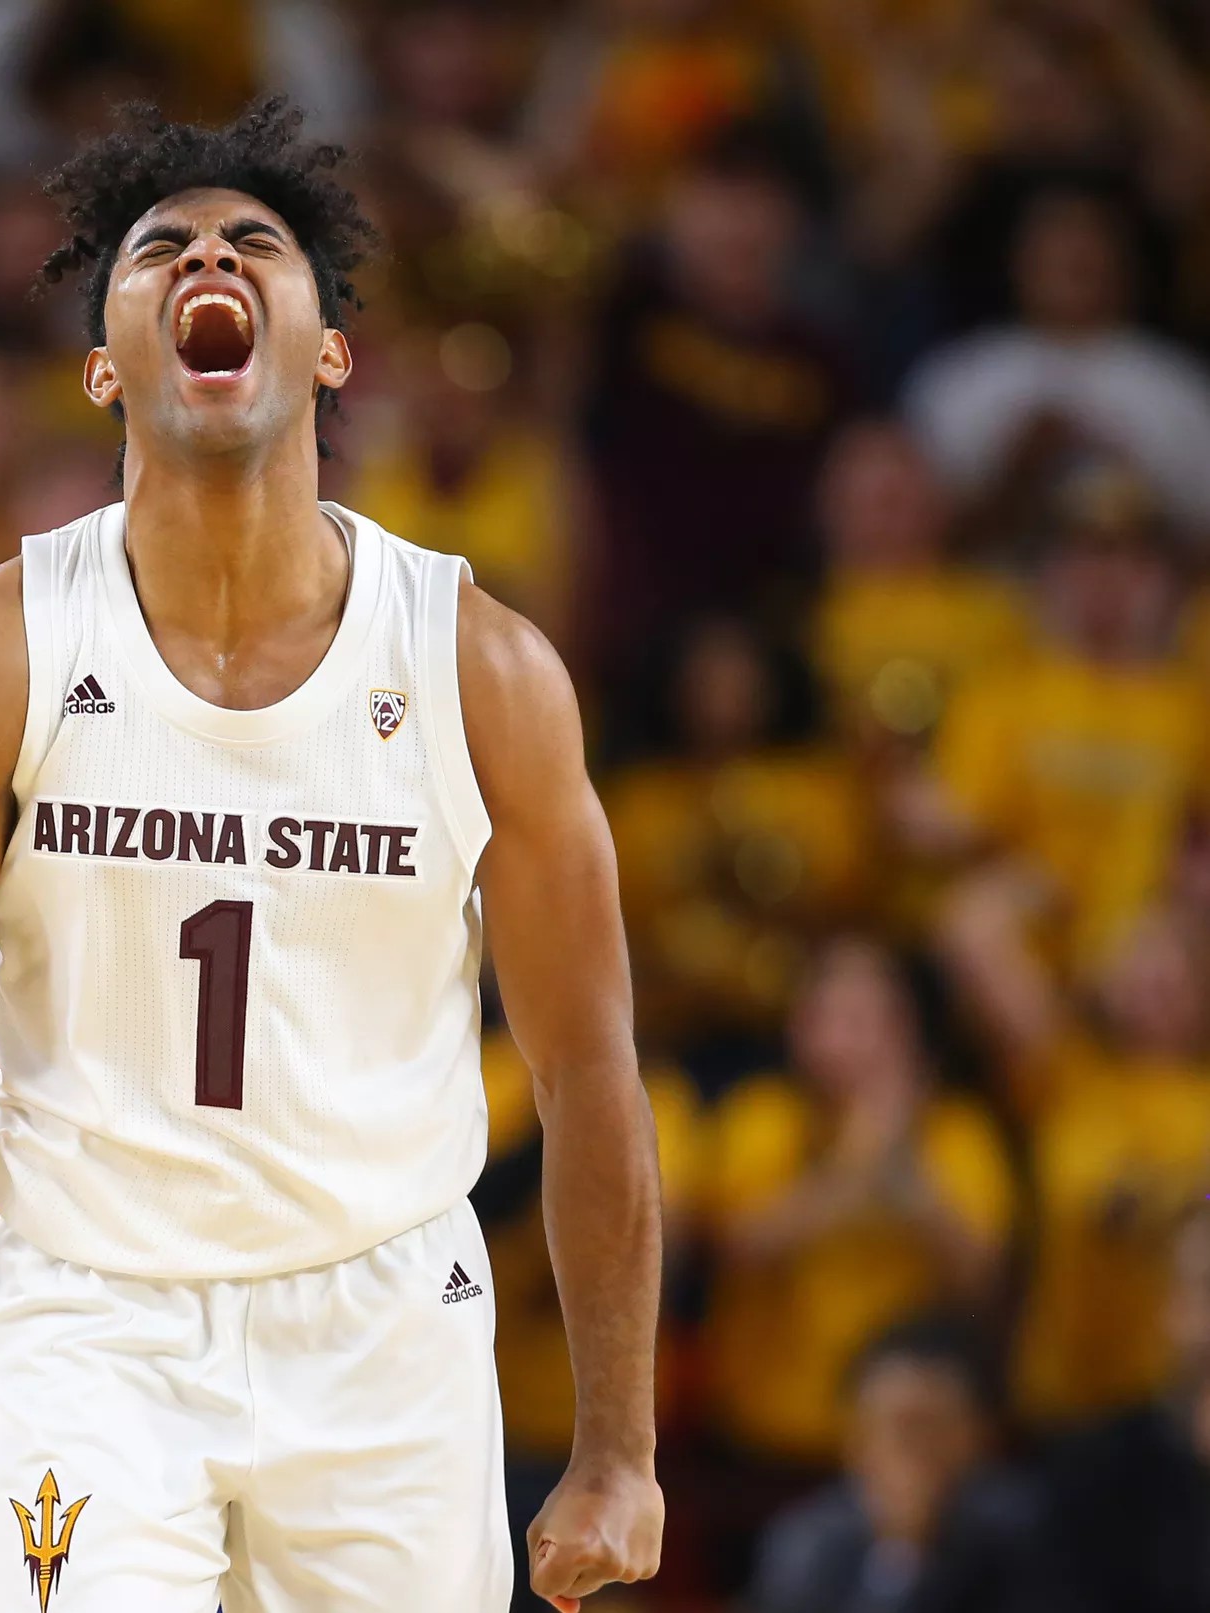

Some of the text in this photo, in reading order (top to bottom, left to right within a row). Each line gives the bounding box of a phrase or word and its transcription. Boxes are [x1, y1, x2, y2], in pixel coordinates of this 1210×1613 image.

[371, 691, 405, 722] PAC
[376, 711, 395, 731] 12
[33, 802, 420, 876] ARIZONA STATE
[179, 899, 254, 1110] 1
[442, 1284, 483, 1304] adidas
